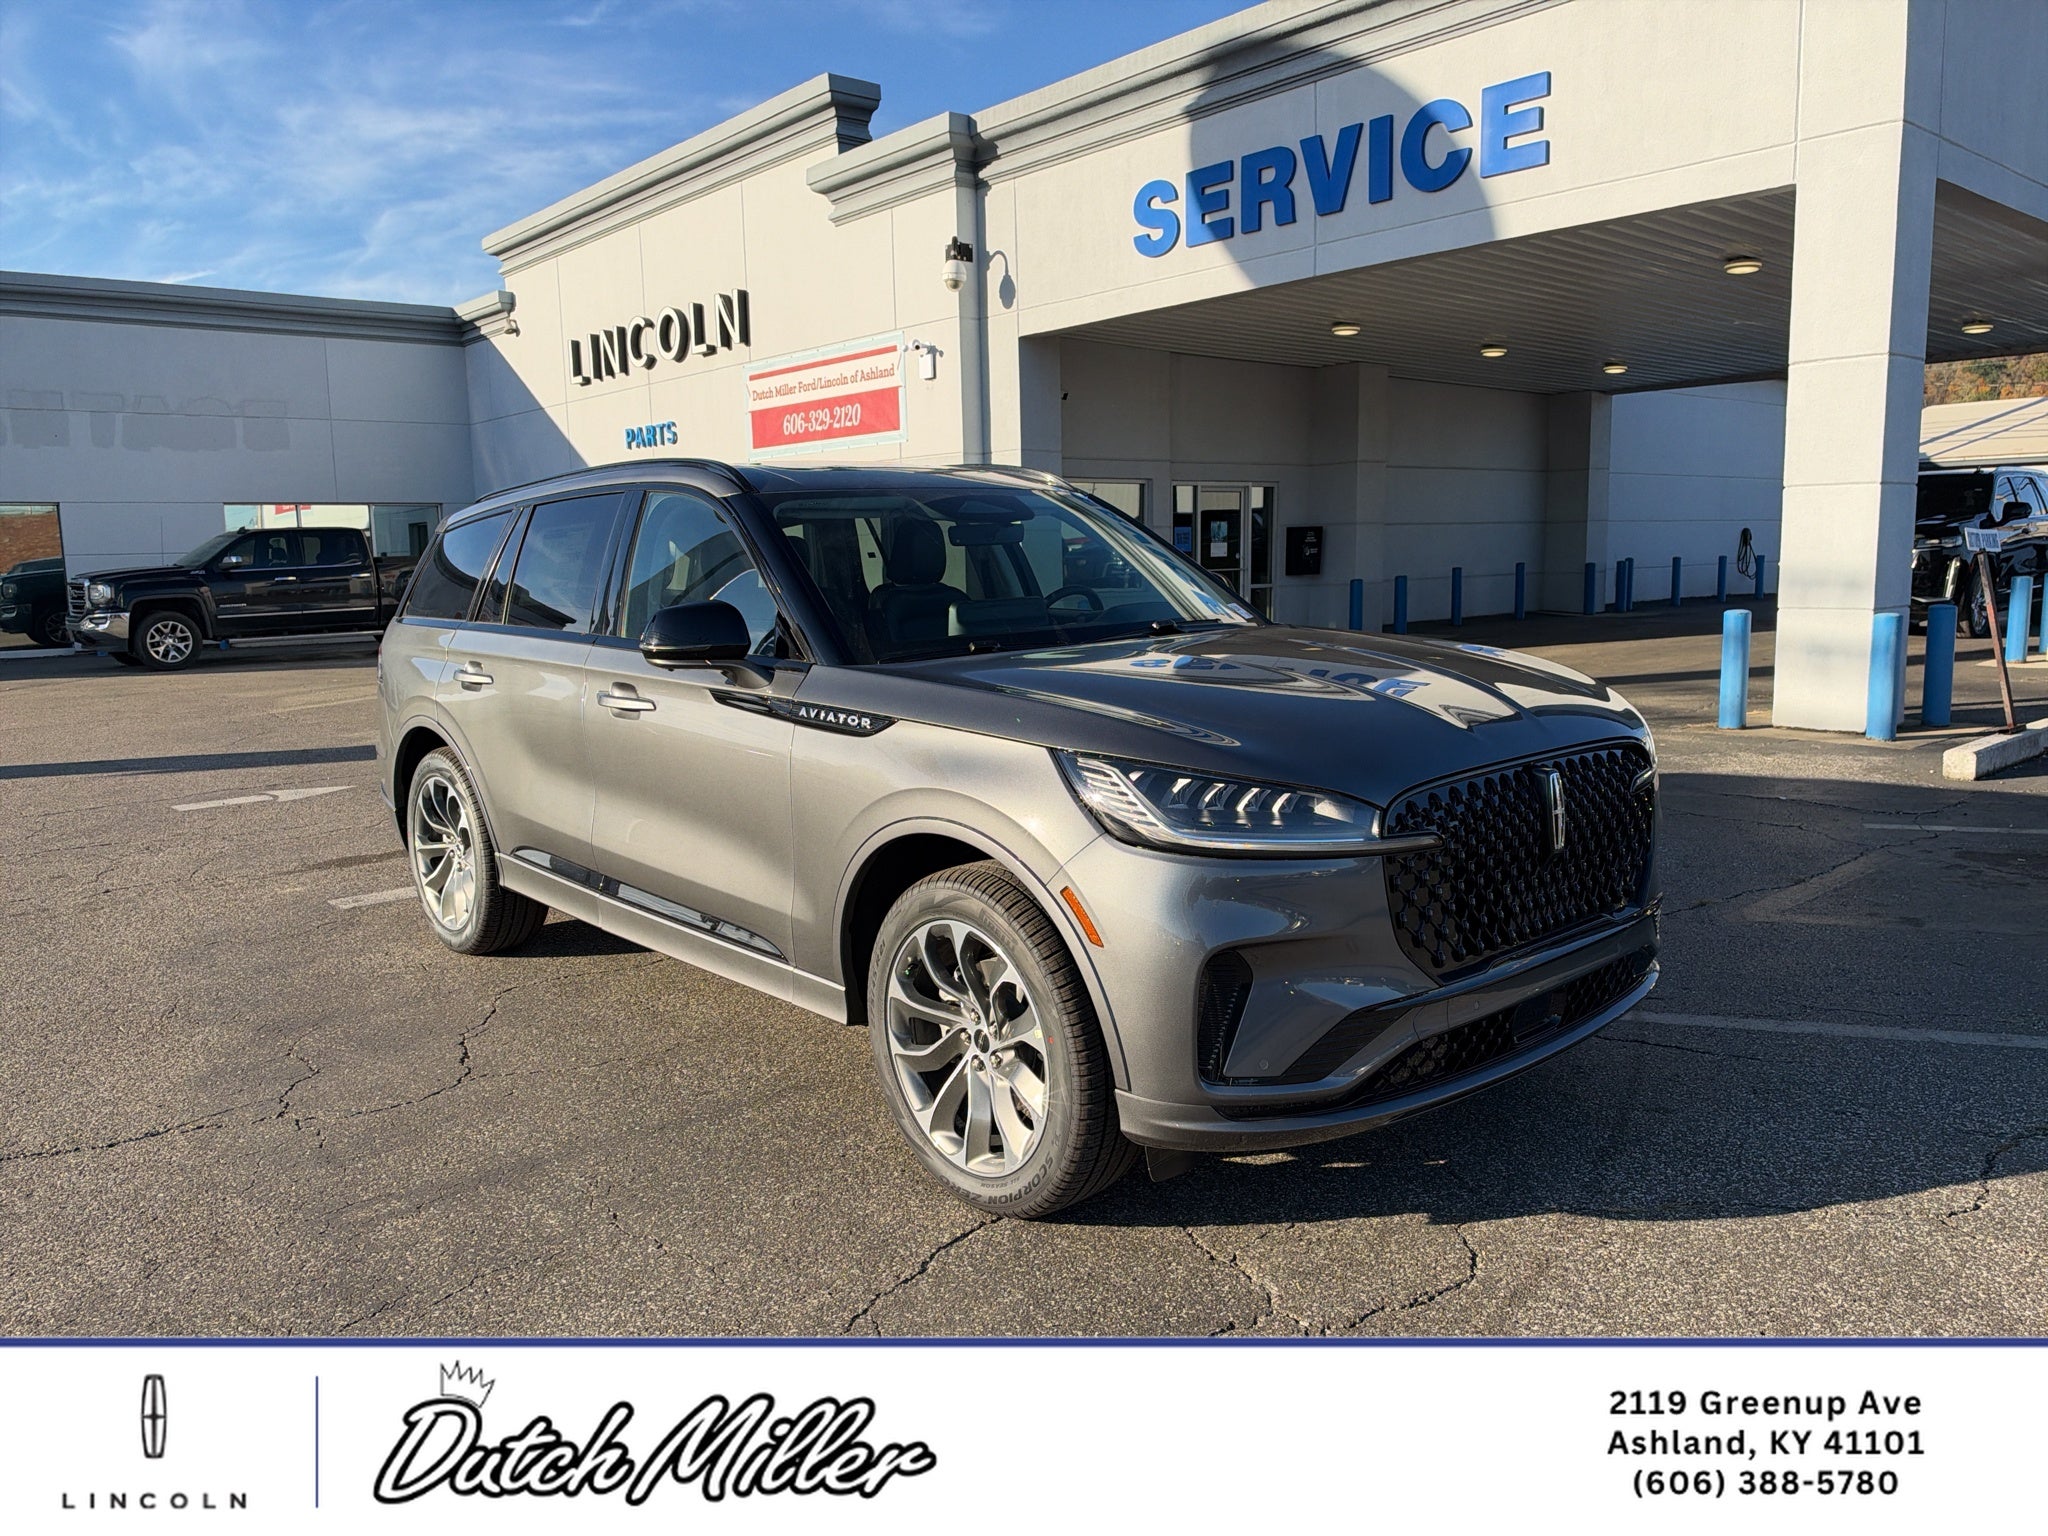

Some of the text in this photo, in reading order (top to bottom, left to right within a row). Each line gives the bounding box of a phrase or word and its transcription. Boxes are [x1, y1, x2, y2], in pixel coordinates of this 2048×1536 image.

[1133, 71, 1551, 258] SERVICE
[568, 288, 751, 386] LINCOLN
[752, 363, 895, 402] Dutch Miller Ford/Lincoln of Ashland
[625, 421, 678, 450] PARTS
[783, 403, 861, 436] 606-329-2120
[799, 706, 872, 730] AVIATOR
[939, 1151, 1054, 1205] SCORPION ZERO
